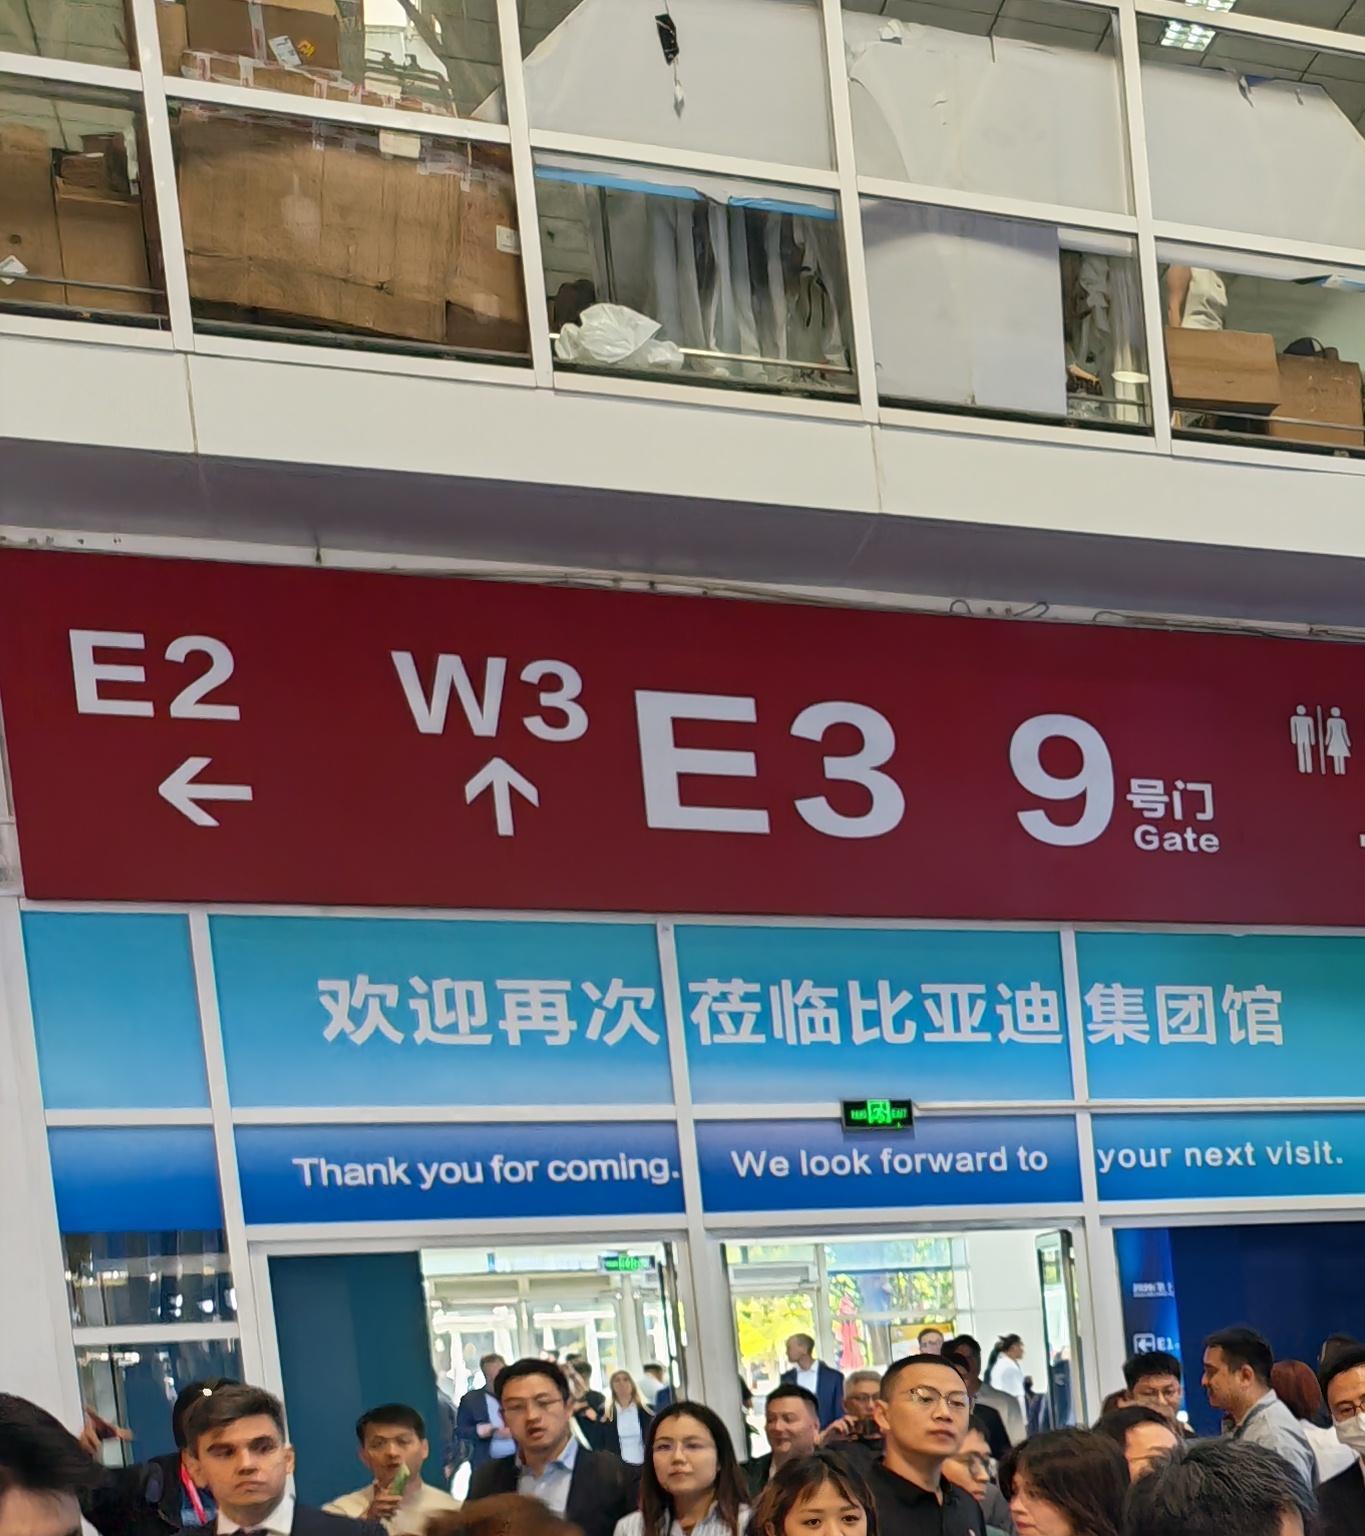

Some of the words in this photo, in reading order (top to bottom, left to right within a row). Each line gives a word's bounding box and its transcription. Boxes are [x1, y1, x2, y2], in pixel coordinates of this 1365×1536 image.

[69, 628, 241, 722] E2
[391, 650, 589, 742] W3
[634, 689, 906, 839] E3
[1008, 713, 1116, 847] 9
[1125, 778, 1216, 822] 号门
[1133, 824, 1221, 855] Gate
[292, 1156, 411, 1189] Thank
[419, 1160, 484, 1192] you
[489, 1152, 540, 1184] for
[547, 1151, 681, 1187] coming.
[731, 1149, 790, 1180] We
[800, 1149, 871, 1178] look
[881, 1147, 1009, 1176] forward
[1018, 1147, 1049, 1174] to
[1097, 1145, 1171, 1174] your
[1184, 1141, 1256, 1169] next
[1266, 1139, 1345, 1168] visit.
